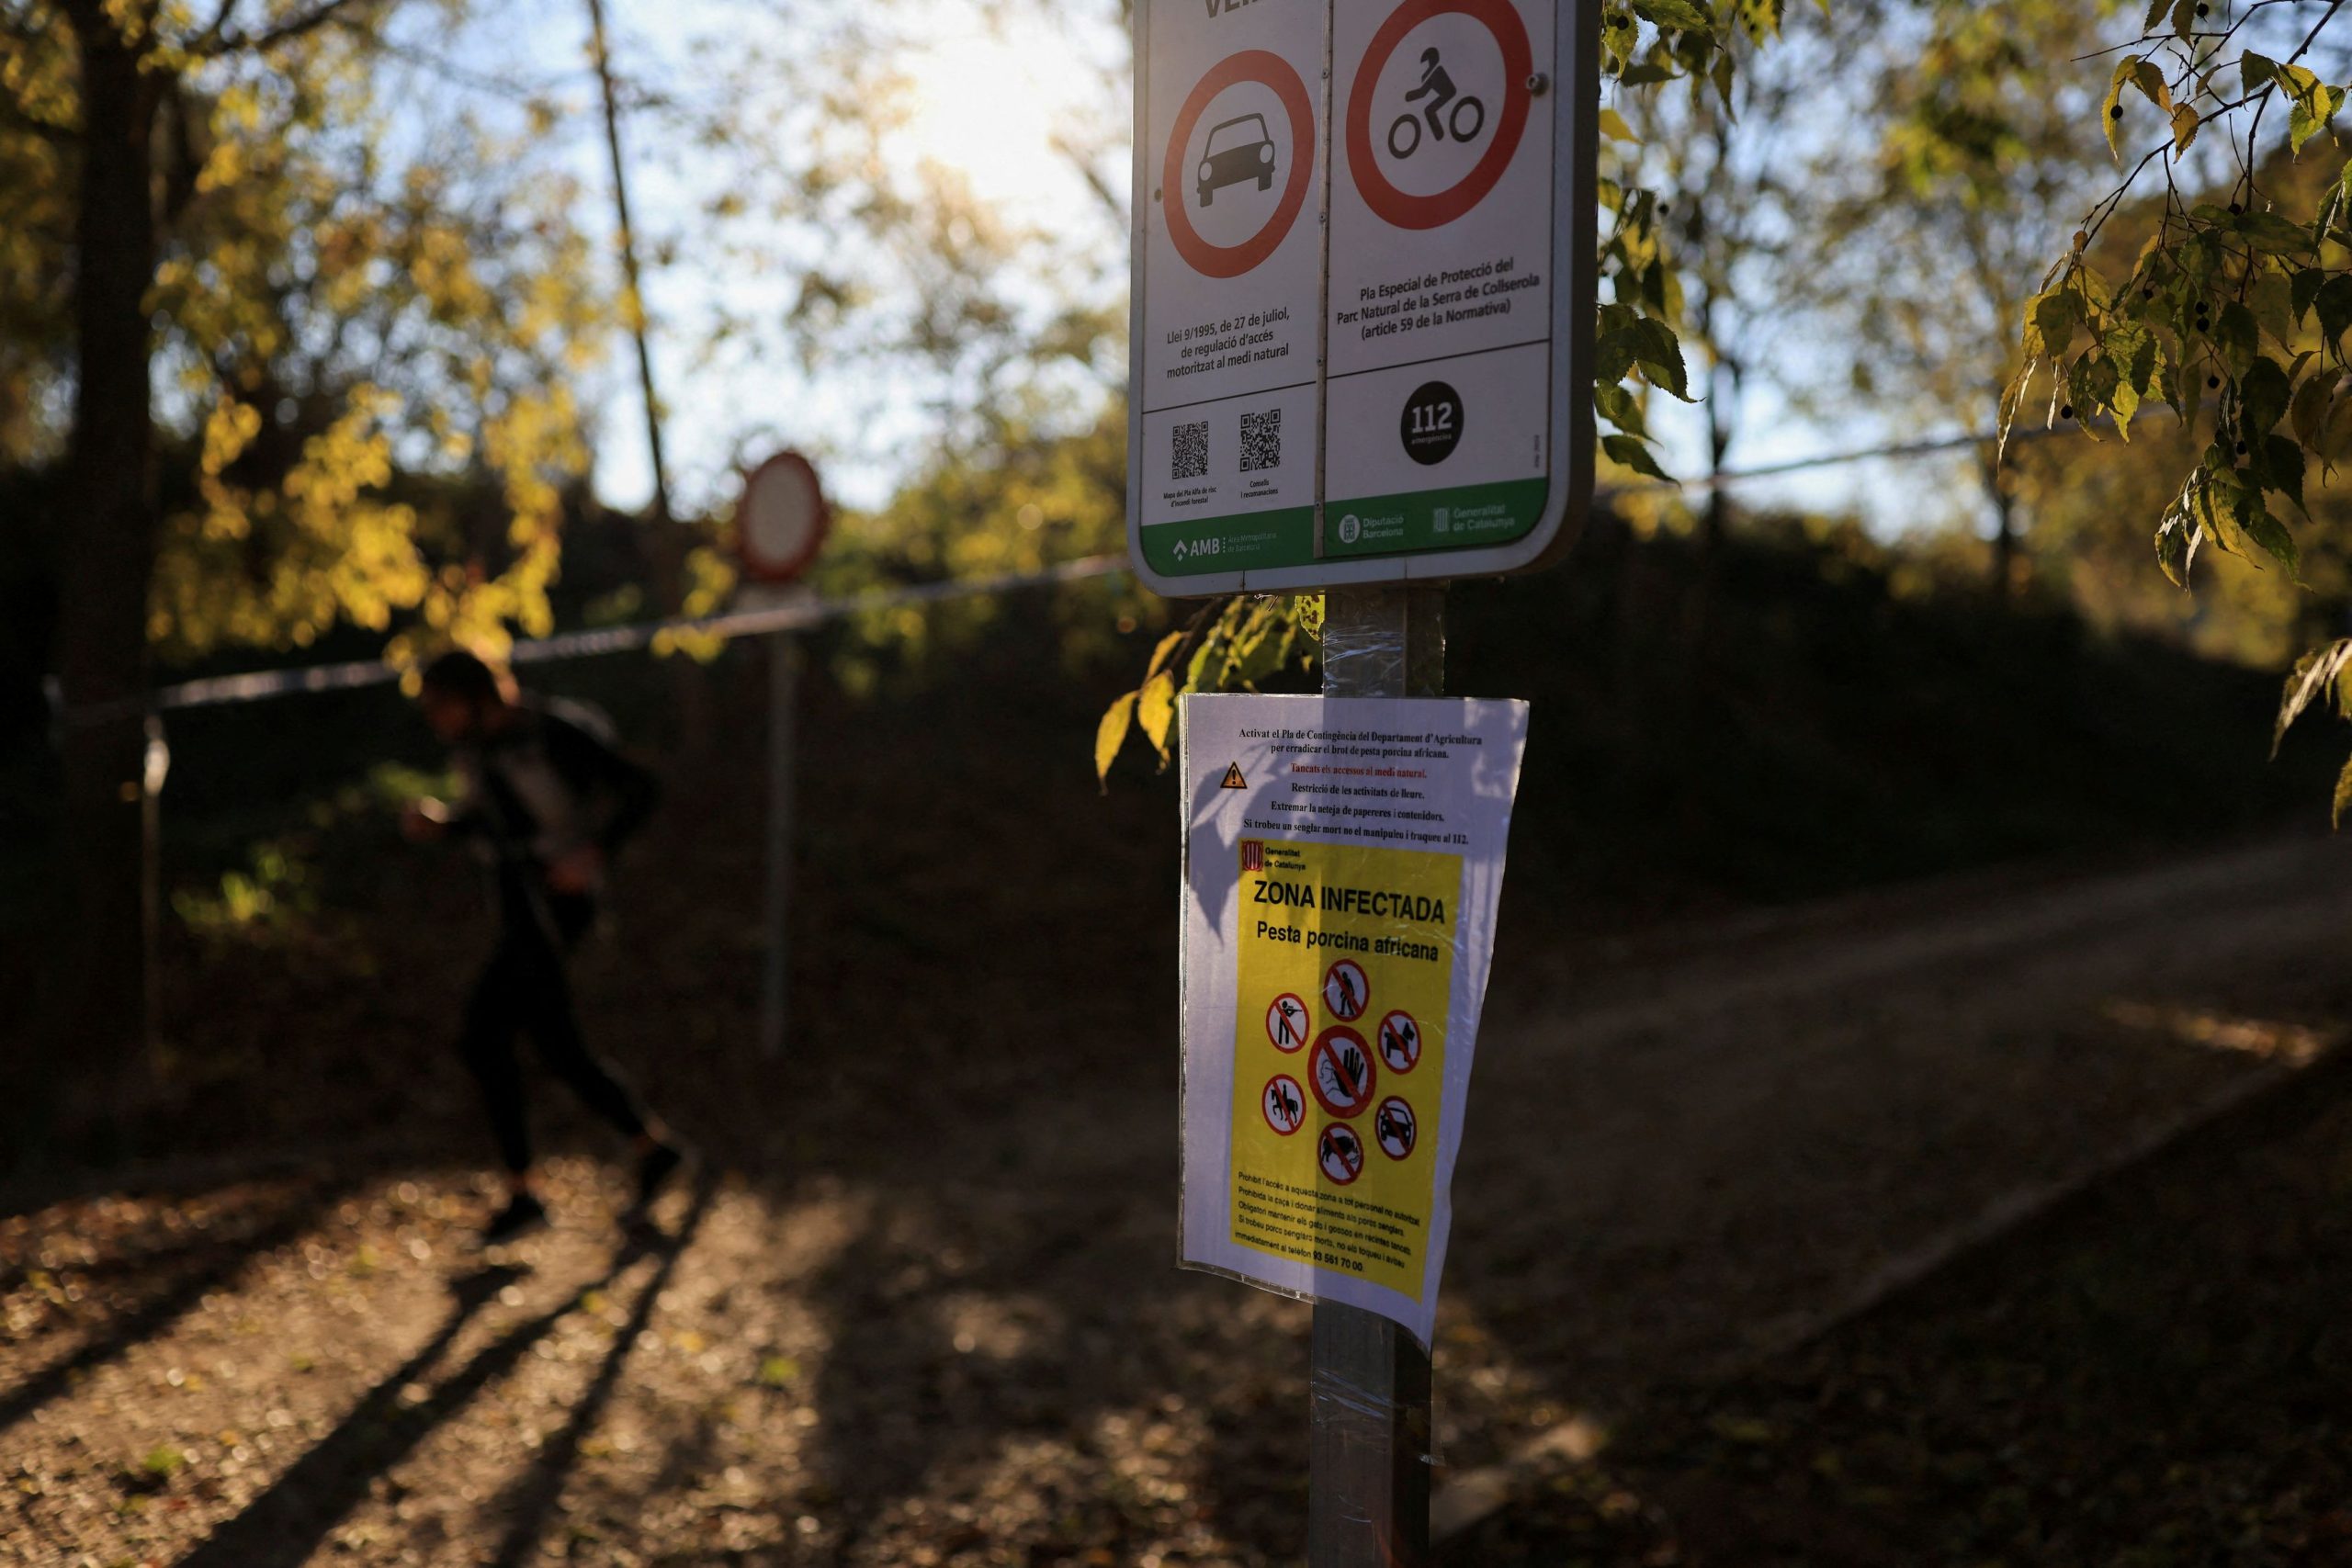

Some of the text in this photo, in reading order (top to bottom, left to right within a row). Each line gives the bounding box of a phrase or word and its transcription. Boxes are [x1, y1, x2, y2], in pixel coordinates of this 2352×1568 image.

[1360, 256, 1514, 301] Pla Especial de Protecció del
[1337, 273, 1540, 324] Parc Natural de la Serra de Collserola
[1167, 307, 1290, 344] Llei 9/1995, de 27 de juliol,
[1361, 298, 1510, 341] (article 59 de la Normativa)
[1181, 329, 1273, 358] de regulació d'accés
[1167, 343, 1289, 378] motoritzat al medi natural
[1411, 401, 1453, 433] 112
[1192, 488, 1201, 496] Alfa
[1363, 514, 1404, 528] Diputació
[1453, 504, 1506, 519] Generalitat
[1363, 527, 1404, 538] Barcelona
[1453, 517, 1515, 531] de Catalunya
[1190, 537, 1220, 557] AMB
[1238, 728, 1270, 738] Activat
[1272, 729, 1279, 739] el
[1282, 729, 1294, 739] Pla
[1295, 730, 1306, 739] de
[1306, 730, 1356, 742] Contingència
[1358, 731, 1370, 741] del
[1371, 731, 1423, 744] Departament
[1271, 744, 1450, 759] per erradicar el brot de pesta porcina africana.
[1291, 763, 1427, 779] Tancats els accessos al medi natural.
[1292, 783, 1425, 799] Restricció de les activitats de lleure.
[1271, 801, 1444, 822] Extremar la neteja de papereres i contenidors.
[1244, 818, 1469, 845] Si trobeu un senglar mort no el manipuleu i truqueu al 112.
[1265, 847, 1300, 857] Generalitat
[1274, 860, 1306, 872] Catalunya
[1253, 880, 1445, 924] ZONA INFECTADA
[1257, 920, 1438, 961] Pesta porcina africana
